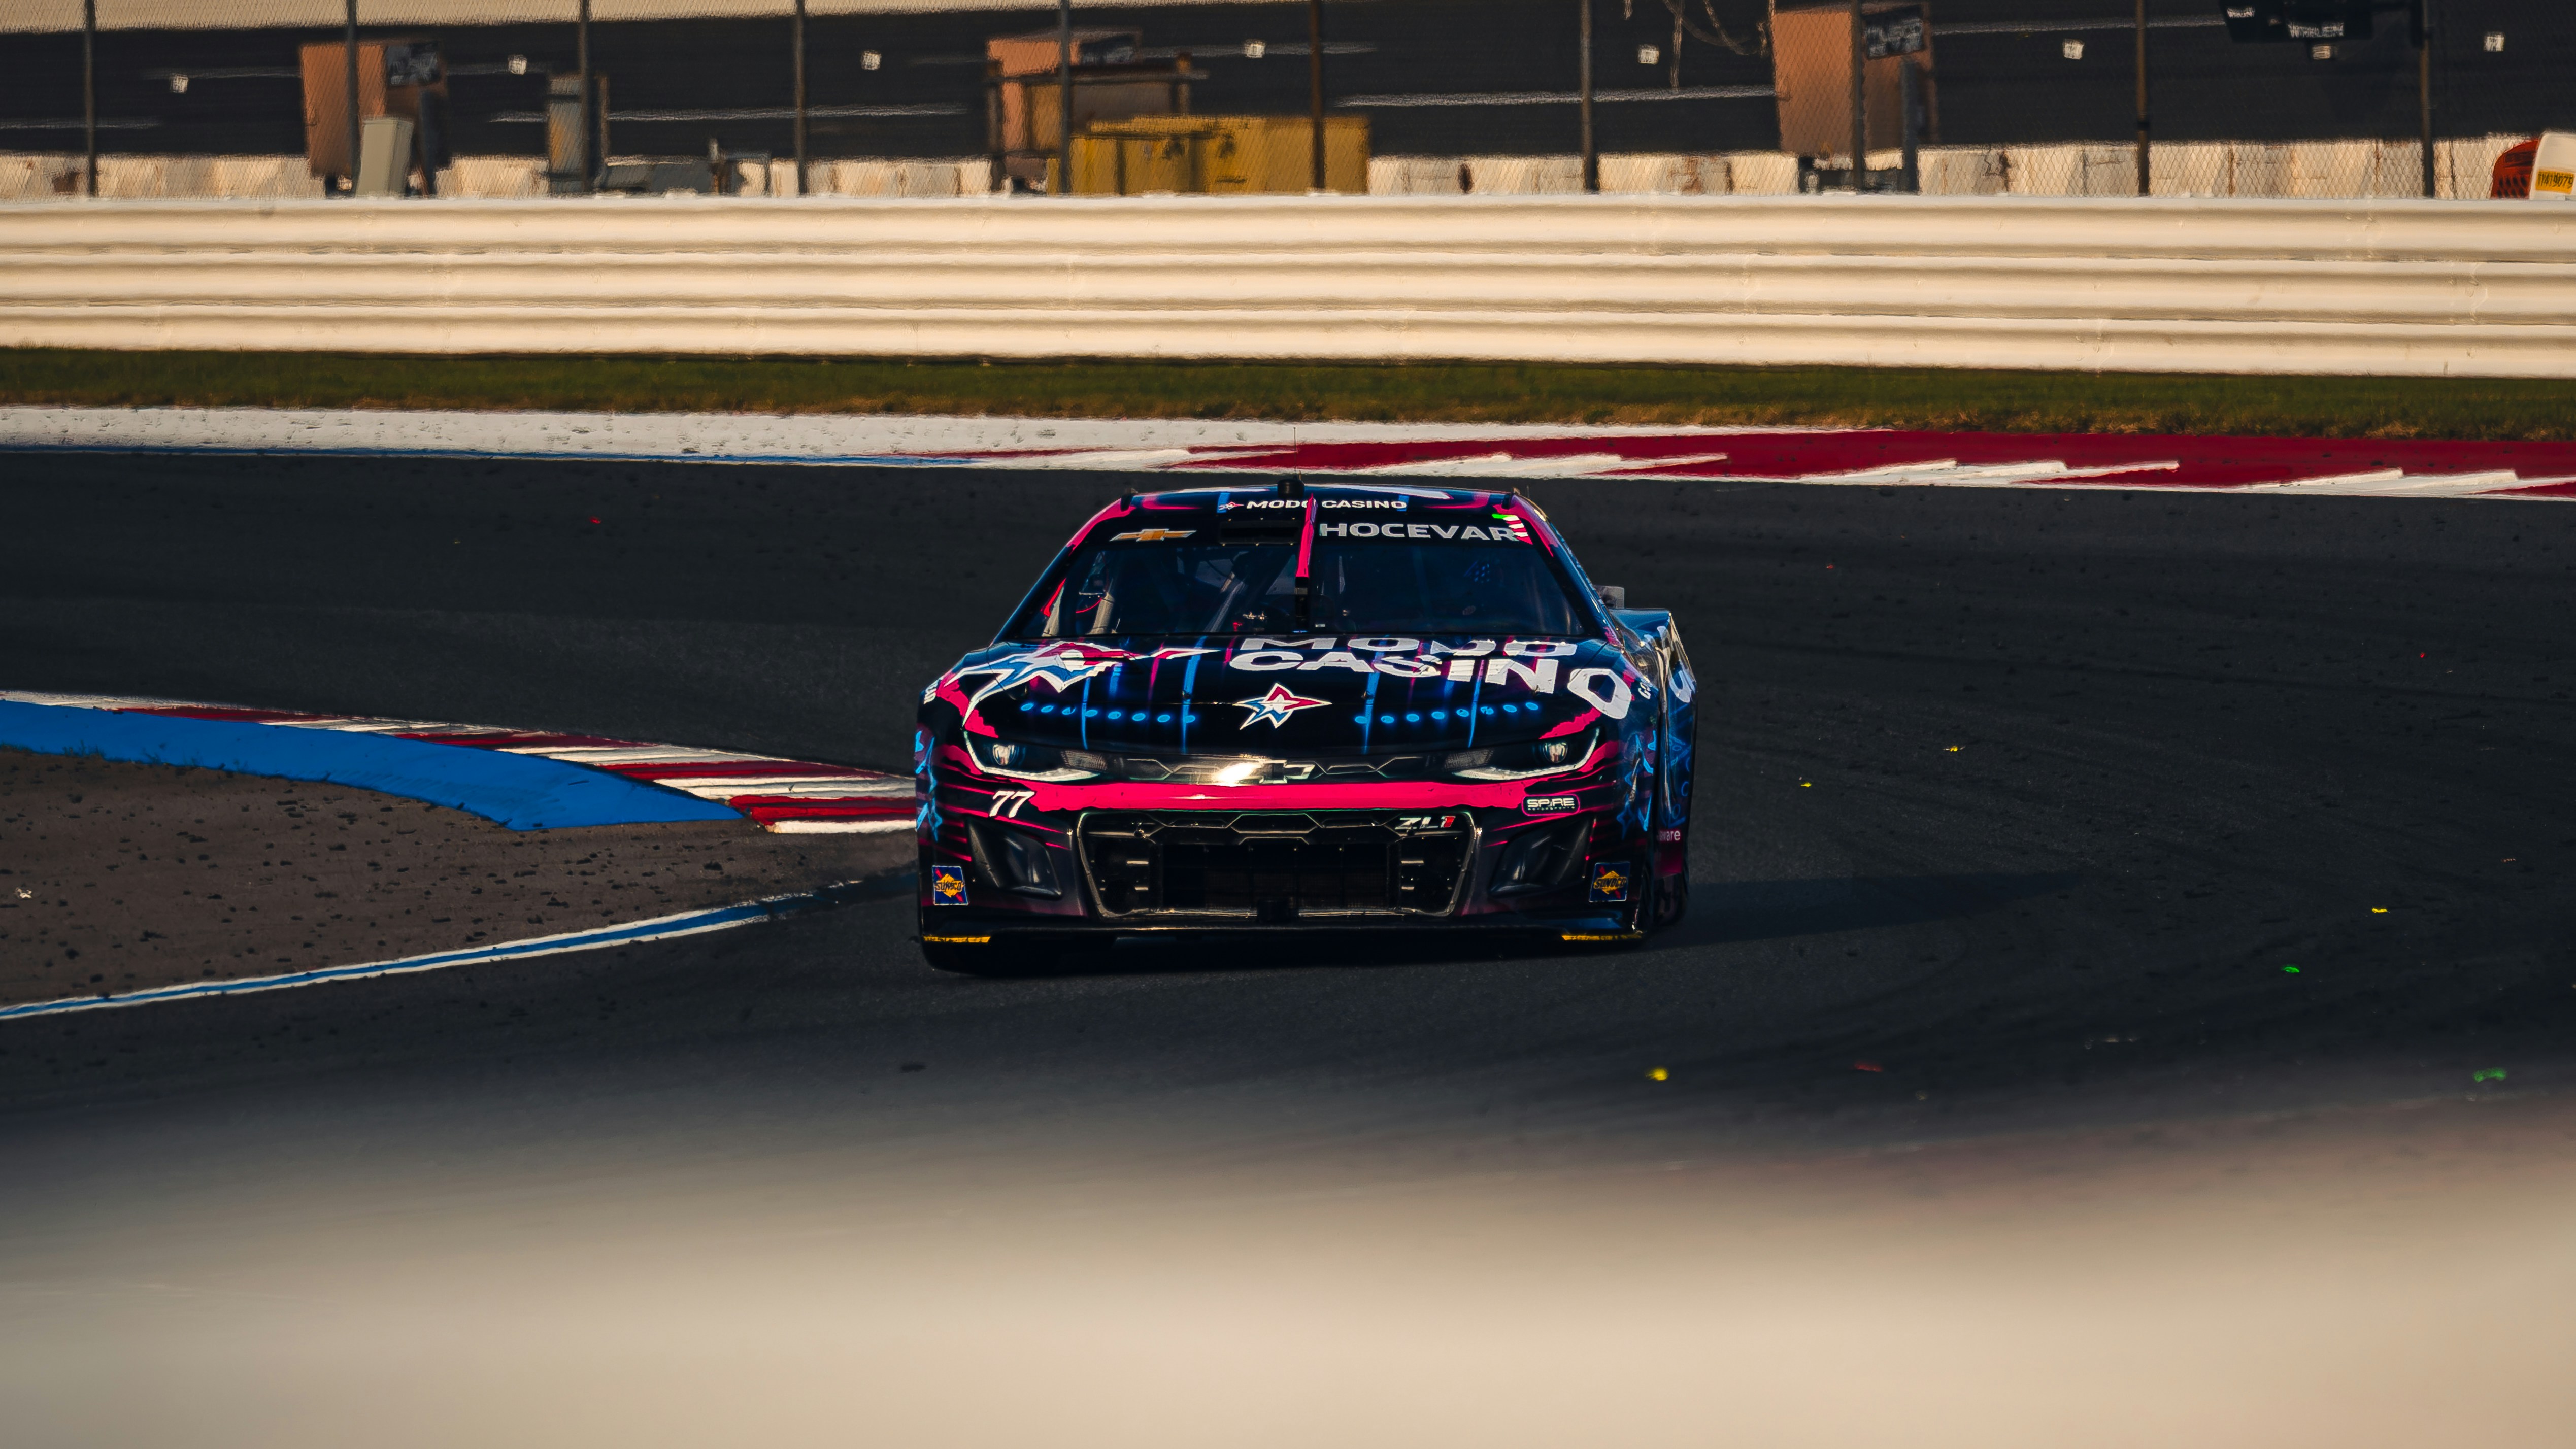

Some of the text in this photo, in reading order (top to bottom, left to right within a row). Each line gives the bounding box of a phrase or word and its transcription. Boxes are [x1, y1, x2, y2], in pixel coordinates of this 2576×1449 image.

[1322, 500, 1408, 509] CASINO
[1320, 523, 1520, 542] HOCEVAR
[1240, 637, 1578, 657] MODO
[1229, 651, 1632, 719] CASINO
[989, 790, 1035, 818] 77
[1394, 816, 1456, 830] ZL1
